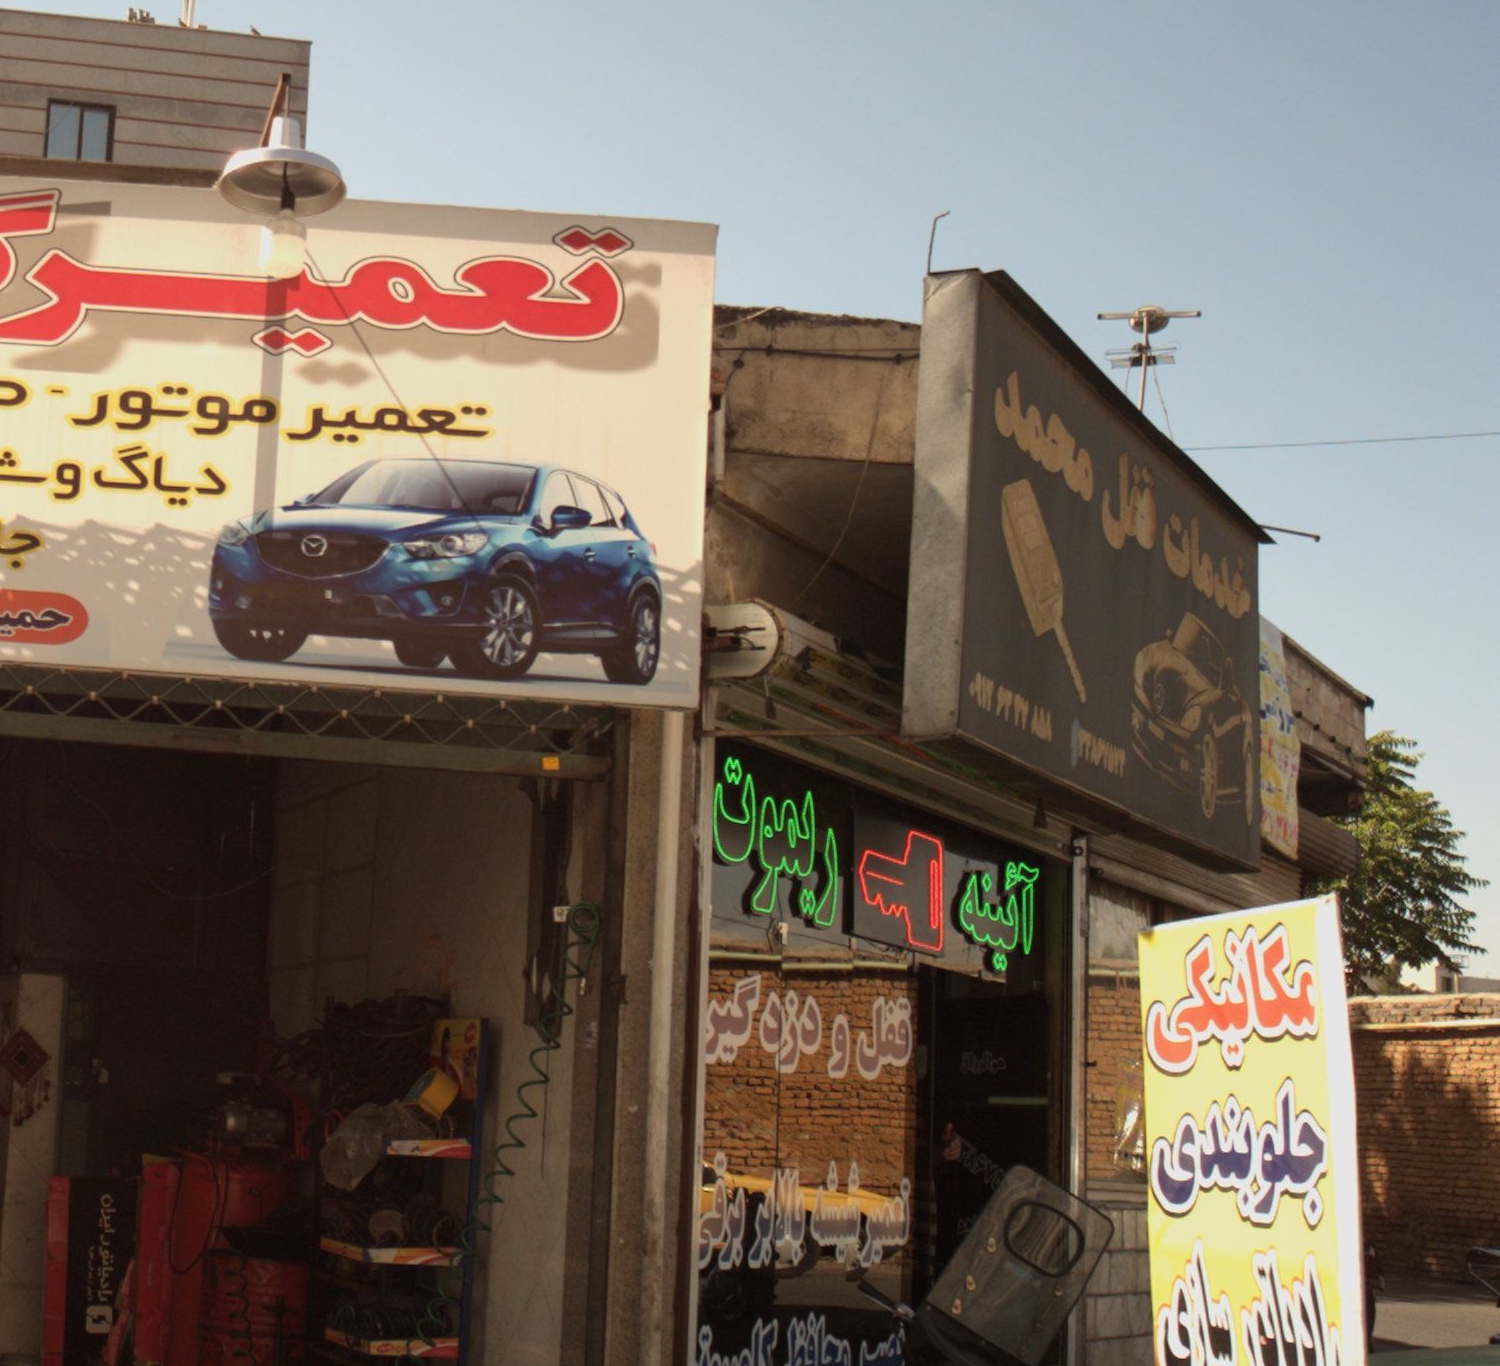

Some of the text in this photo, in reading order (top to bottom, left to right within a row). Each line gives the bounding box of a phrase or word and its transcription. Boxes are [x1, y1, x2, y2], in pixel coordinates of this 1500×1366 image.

[72, 375, 278, 432] موتور
[286, 387, 492, 440] تعمیر
[93, 445, 227, 507] دیاگ
[994, 371, 1251, 621] خدمات قفل محمد
[713, 756, 838, 927] ریموت
[856, 996, 913, 1080] قفل
[1145, 922, 1319, 1076] مکانیکی
[827, 1014, 850, 1079] و
[1150, 1076, 1327, 1228] جلوبندی
